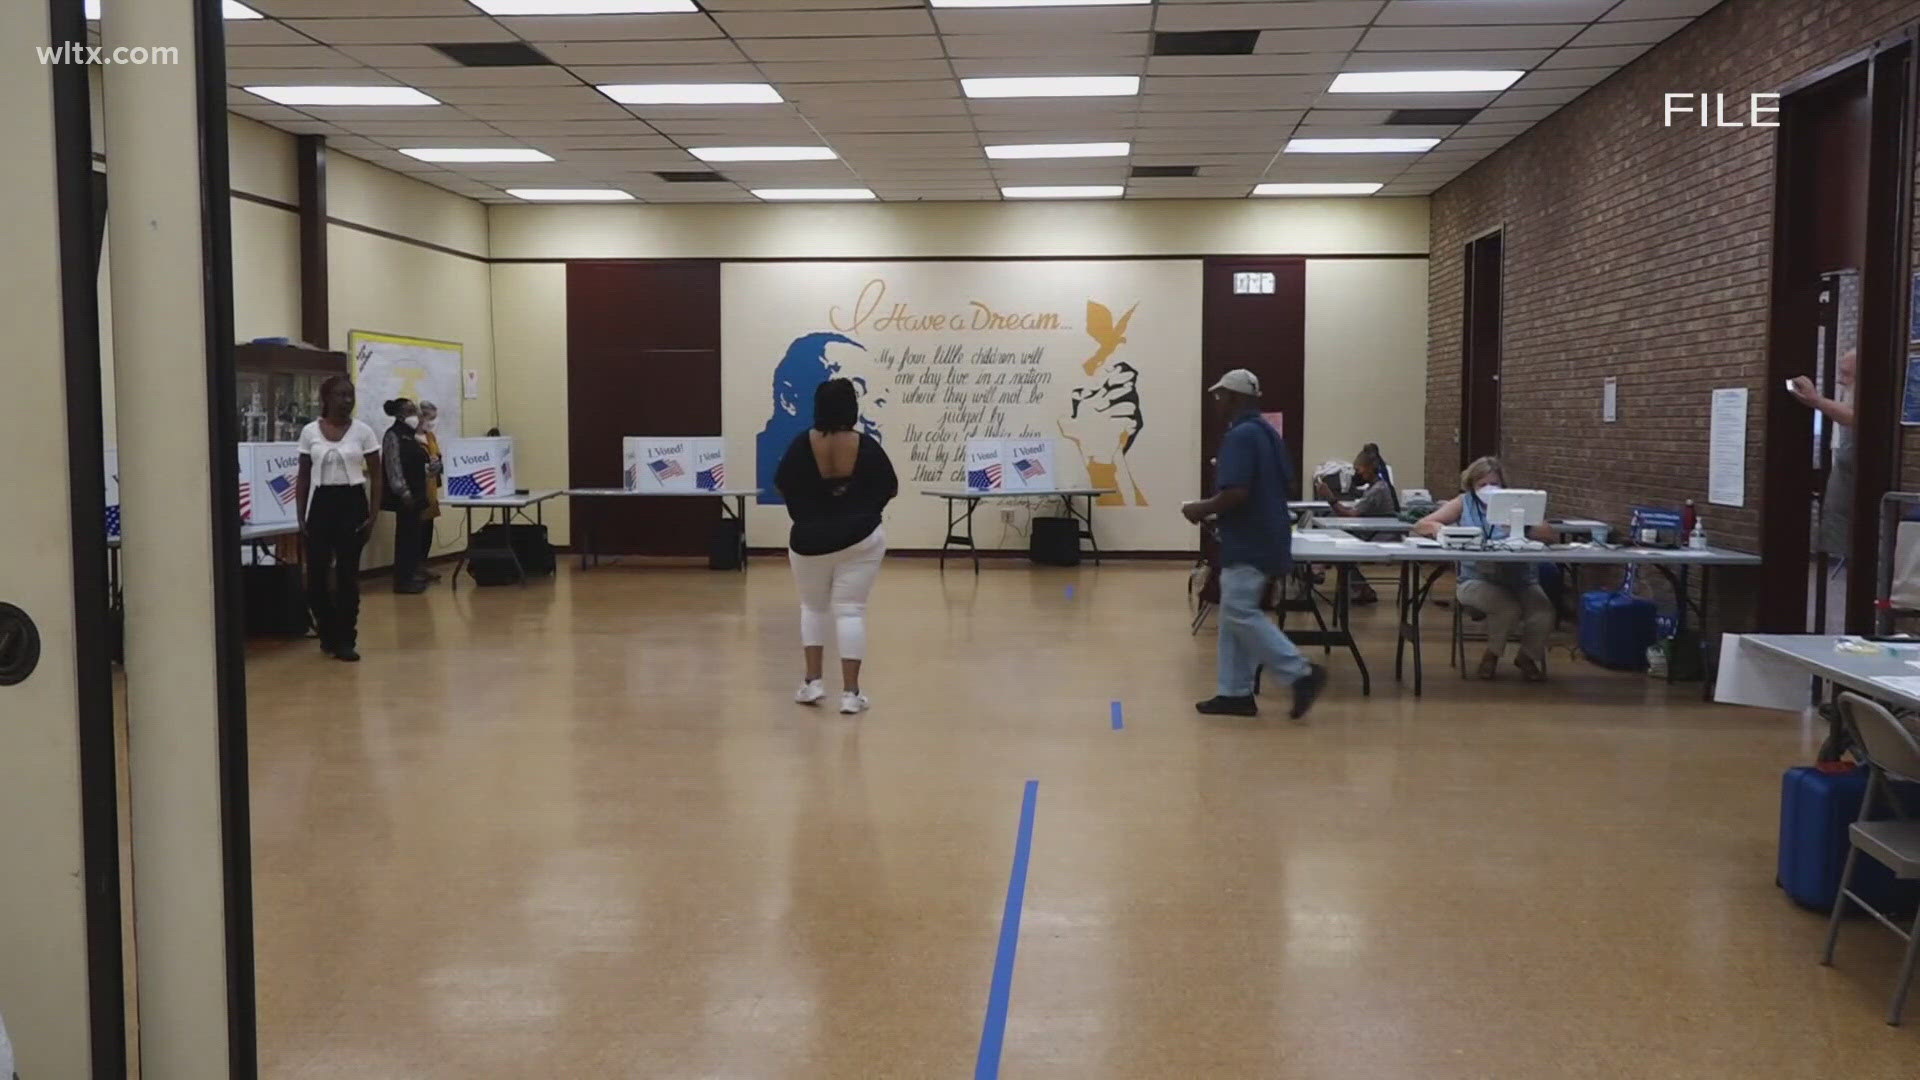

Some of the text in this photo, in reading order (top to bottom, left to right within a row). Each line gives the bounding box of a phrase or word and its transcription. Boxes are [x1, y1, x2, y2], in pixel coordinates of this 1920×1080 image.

[829, 279, 886, 335] I
[873, 303, 945, 331] Have
[950, 313, 964, 331] a
[875, 350, 894, 369] My
[933, 344, 964, 365] little
[971, 346, 1016, 365] children
[1021, 346, 1044, 365] will
[895, 366, 1052, 388] one day live in a nation
[902, 384, 1044, 410] where they will not be
[938, 404, 1005, 431] judged by
[925, 424, 958, 443] color
[453, 452, 490, 467] I Voted
[656, 443, 684, 456] Voted!
[911, 445, 928, 463] but
[935, 444, 949, 468] by
[1019, 443, 1045, 457] Voted!
[266, 459, 273, 472] I
